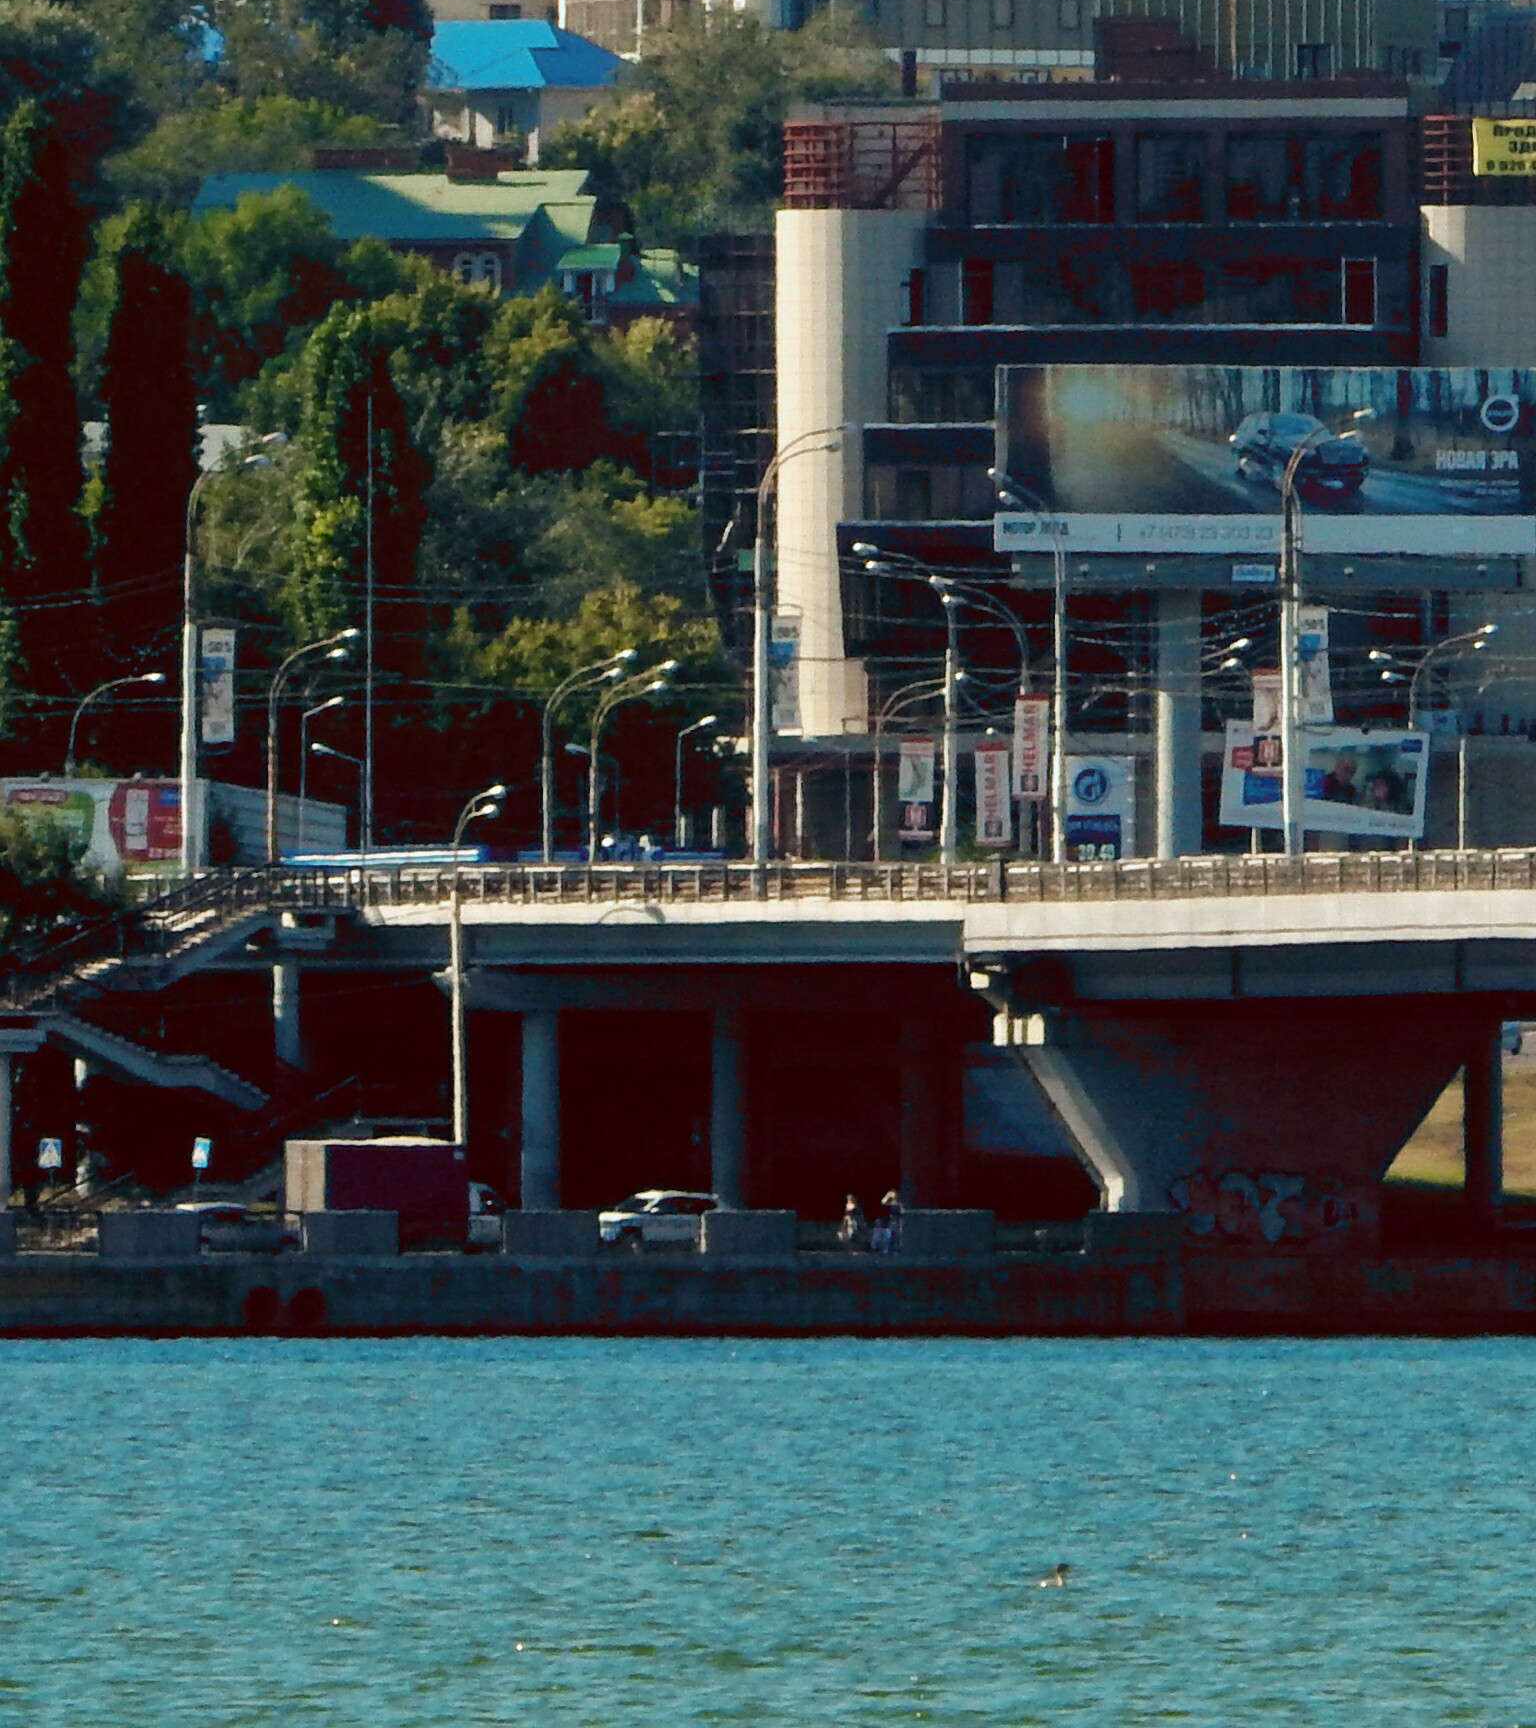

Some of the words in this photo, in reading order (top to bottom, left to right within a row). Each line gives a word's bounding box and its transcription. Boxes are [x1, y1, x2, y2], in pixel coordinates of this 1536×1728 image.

[1435, 449, 1486, 470] НОВАЯ
[1490, 449, 1519, 470] ЭРА
[1022, 703, 1038, 773] HELMAR
[983, 754, 996, 819] HELMAR
